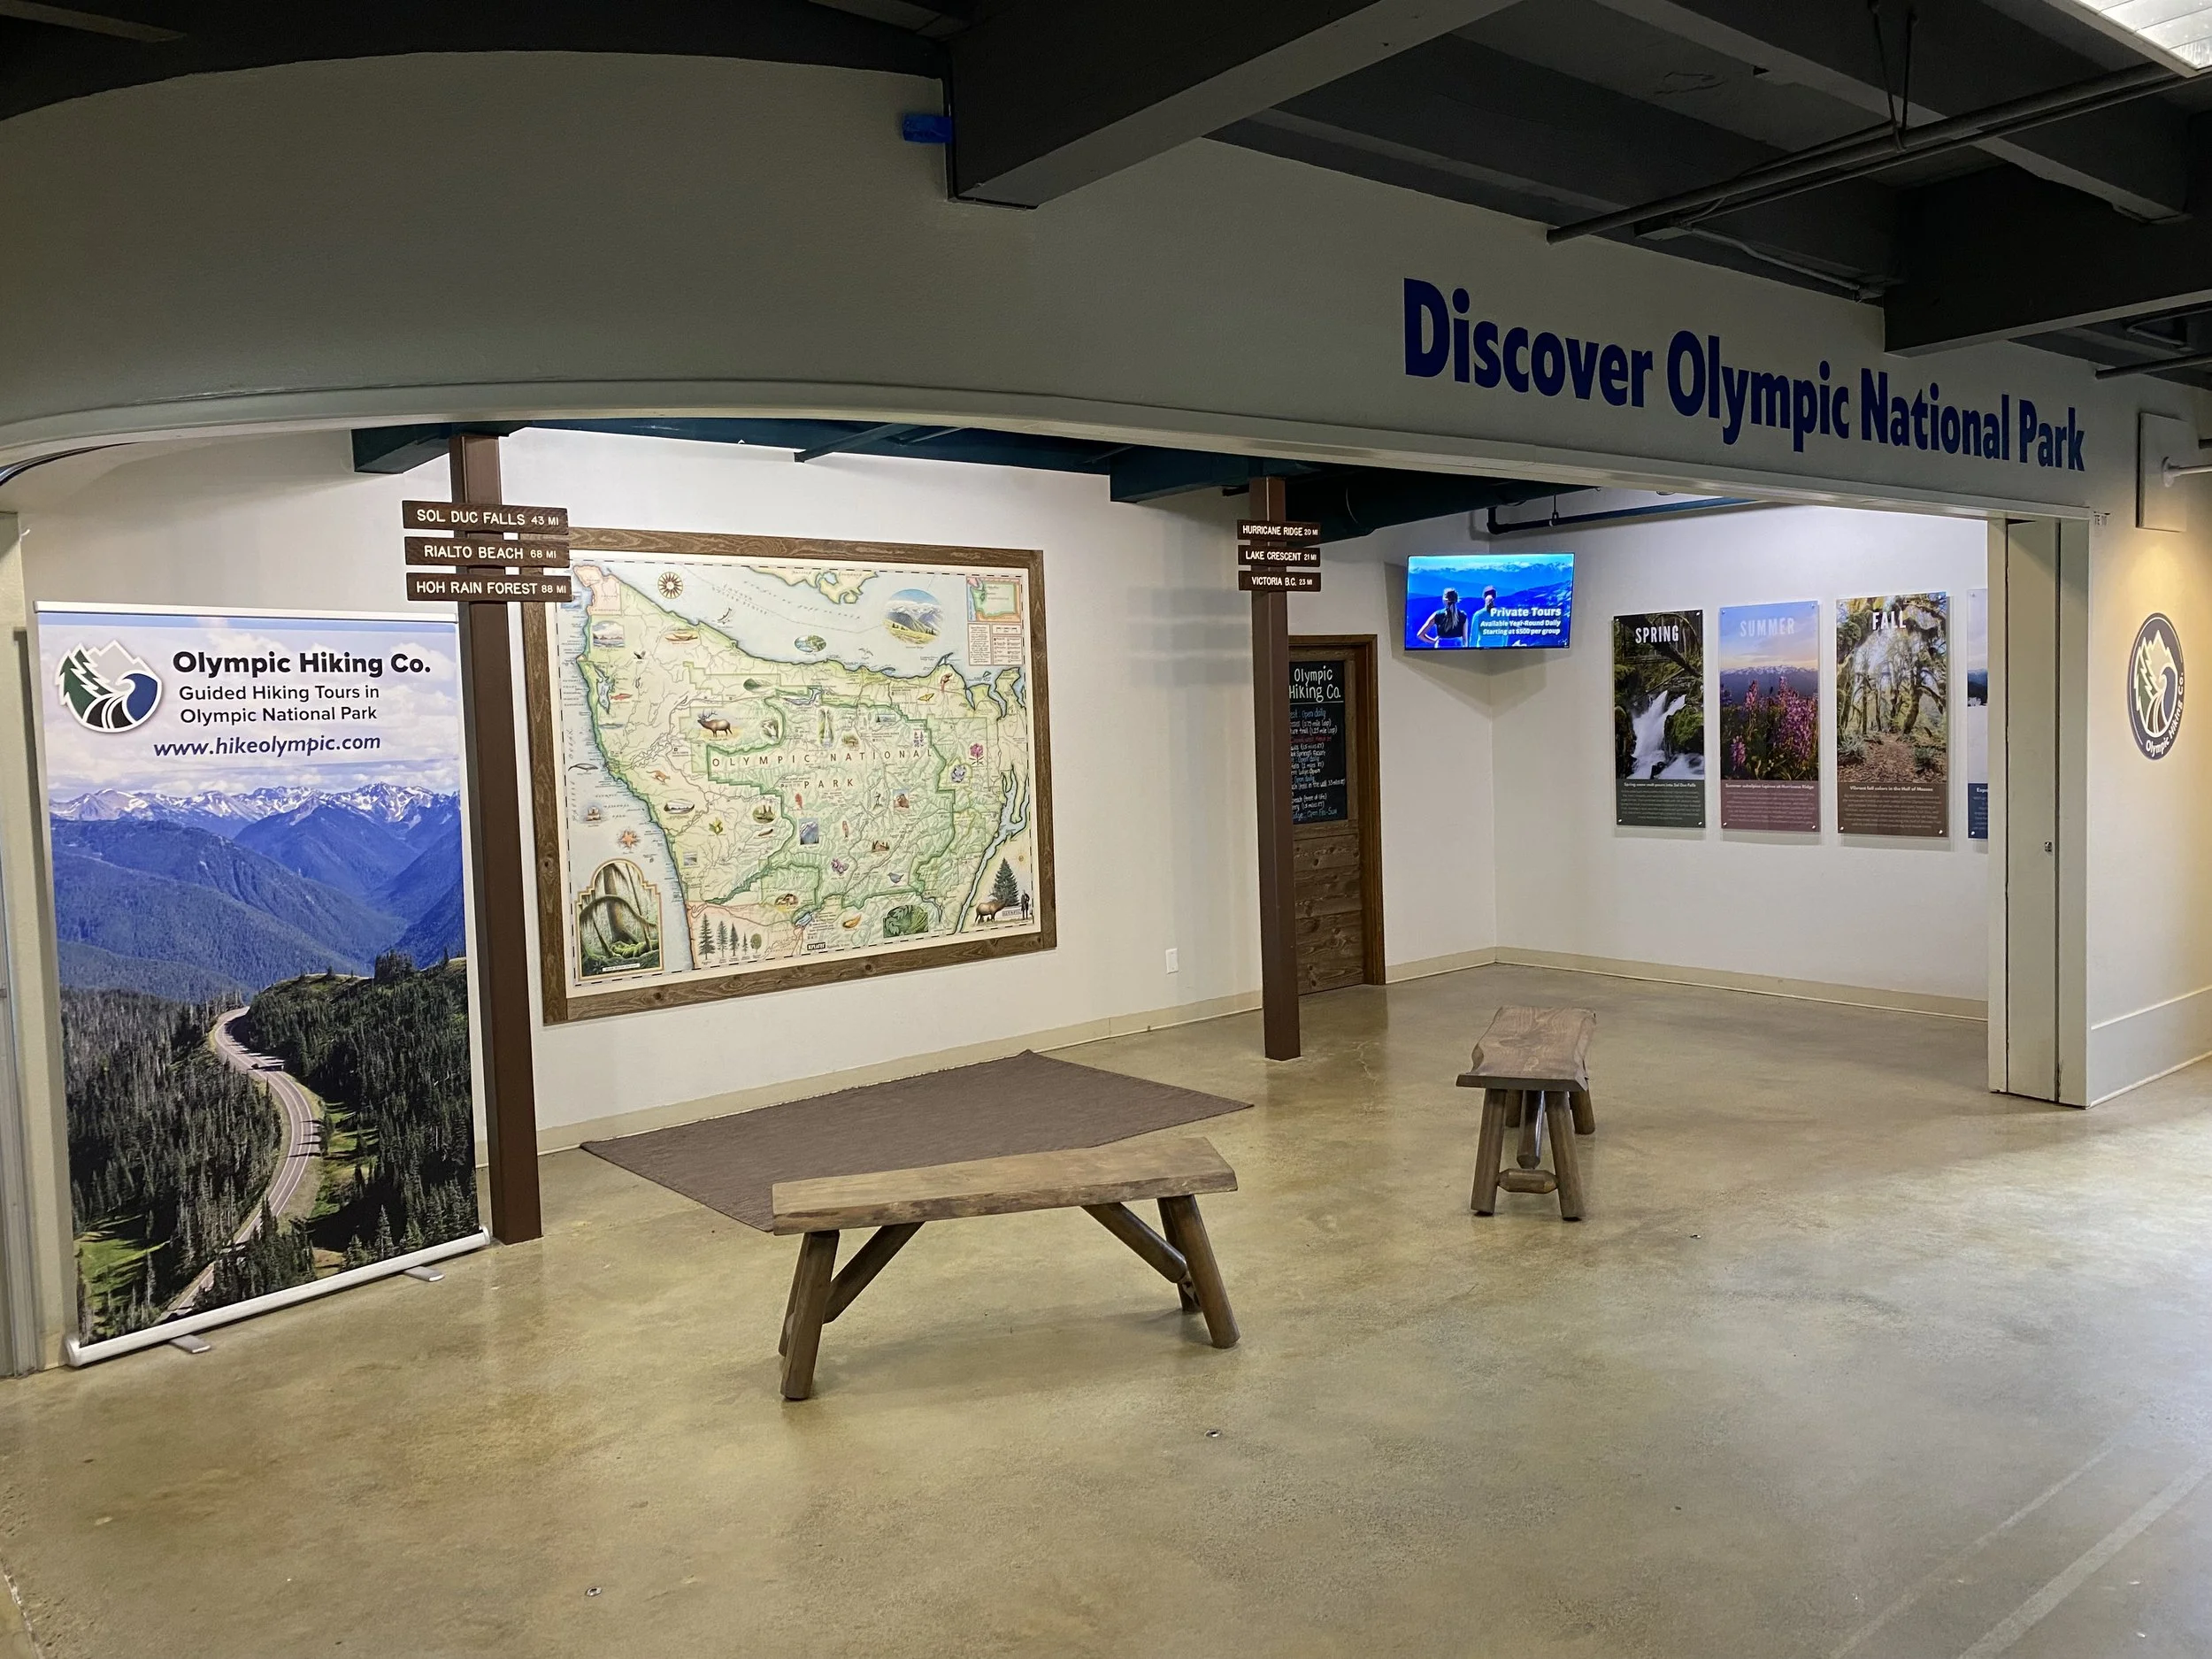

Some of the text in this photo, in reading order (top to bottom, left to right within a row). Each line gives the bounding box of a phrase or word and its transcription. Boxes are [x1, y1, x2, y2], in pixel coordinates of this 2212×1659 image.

[1403, 278, 2085, 472] Discover Olympic National Park
[417, 510, 445, 523] SOL
[450, 511, 479, 524] DUC
[483, 511, 526, 526] FALLS
[530, 516, 545, 526] 43
[1242, 525, 1282, 535] HURRICANE
[1283, 527, 1303, 536] RIDGE
[424, 545, 557, 559] RIALTO BEACH 68 MI
[1245, 550, 1265, 560] LAKE
[1267, 551, 1302, 561] CRESCENT
[416, 580, 567, 595] HOH RAIN FOREST 88 MI
[1251, 576, 1283, 586] VICTORIA
[1285, 577, 1297, 586] B.C.
[1490, 607, 1562, 617] Private Tours
[1871, 611, 1907, 631] FALL
[1635, 625, 1679, 644] SPRING
[1740, 617, 1795, 637] SUMMER
[173, 650, 431, 678] Olympic Hiking Co.
[1294, 665, 1333, 687] Olympic
[179, 684, 380, 703] Guided Hiking Tours in
[1288, 683, 1341, 703] Hiking Co.
[180, 706, 378, 726] Olympic National Park
[2145, 736, 2170, 757] Olympic
[2168, 702, 2184, 740] Hiking
[153, 735, 381, 757] www.hikeolympic.com
[711, 748, 933, 768] OLYMPIC NATIONAL
[803, 778, 854, 789] PARK
